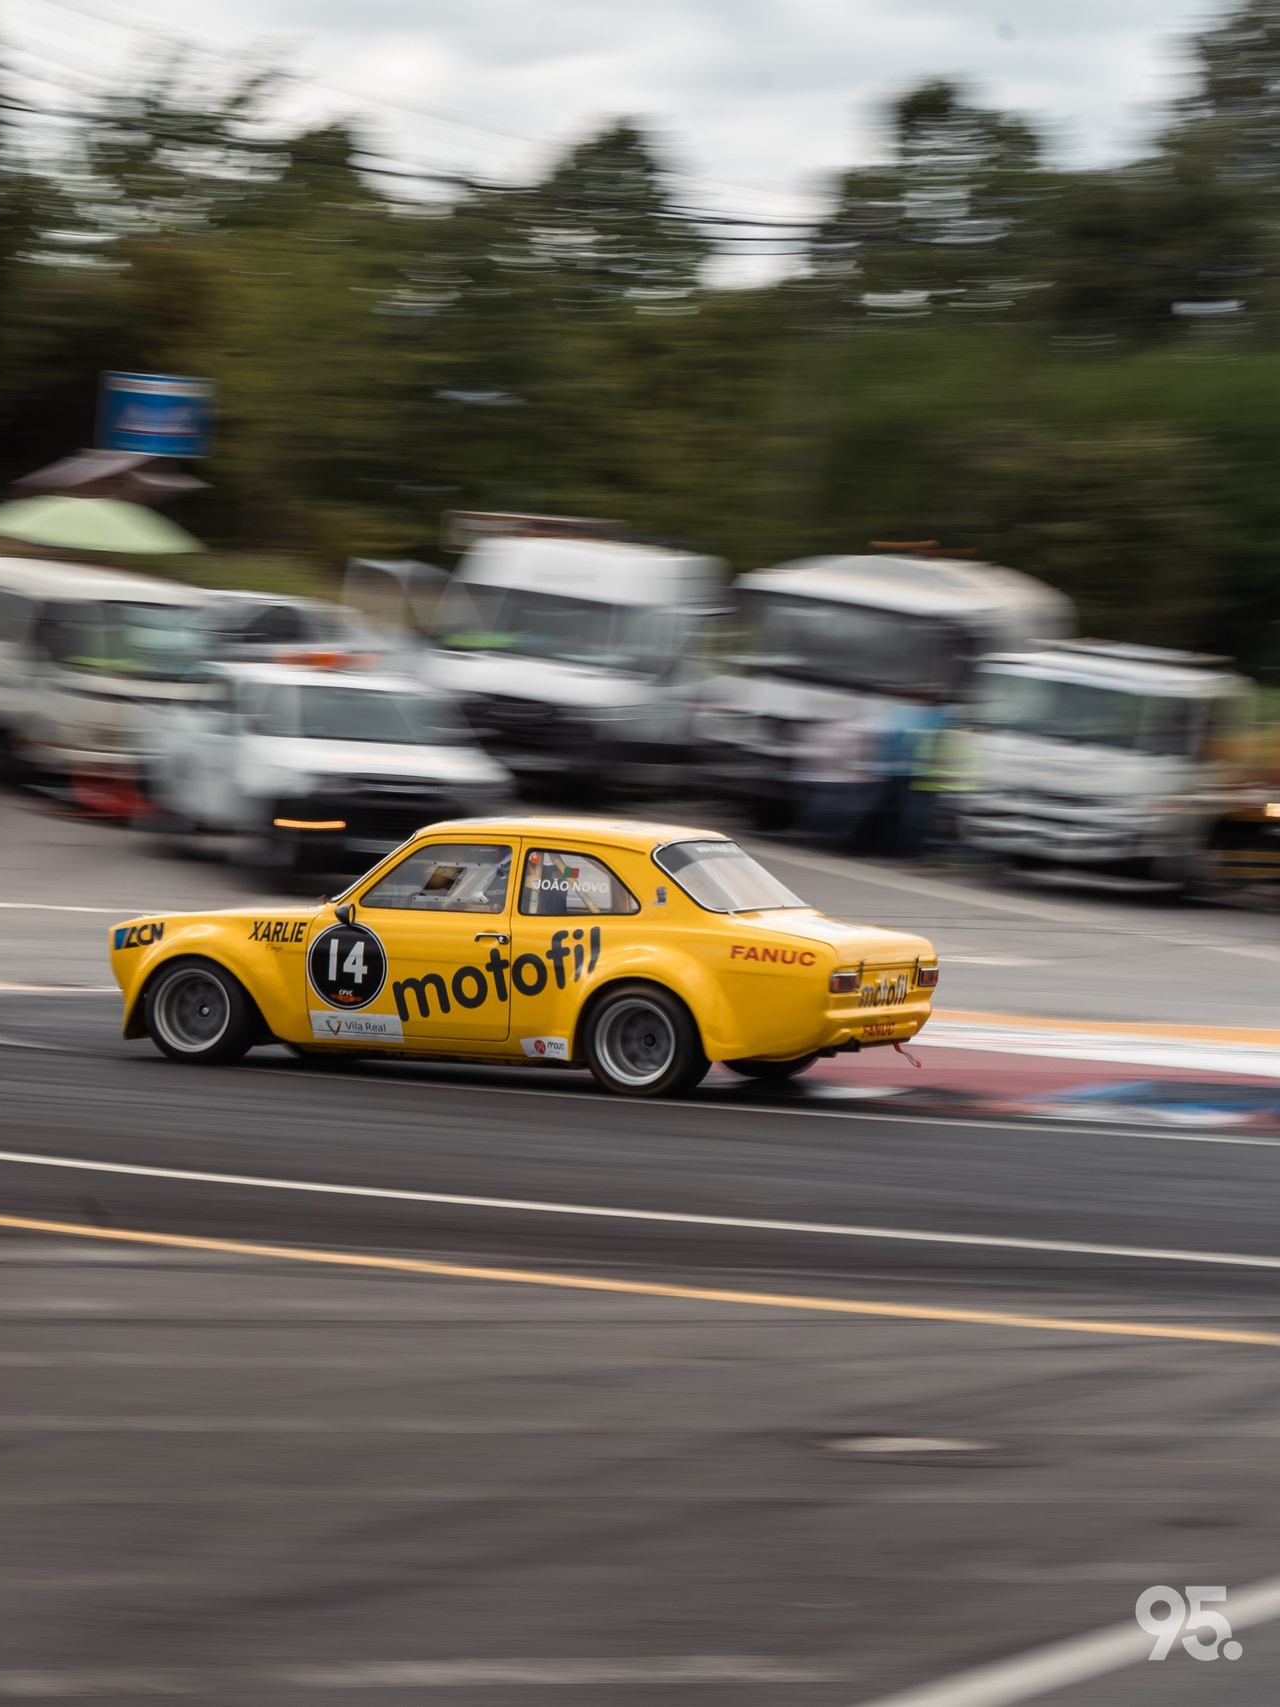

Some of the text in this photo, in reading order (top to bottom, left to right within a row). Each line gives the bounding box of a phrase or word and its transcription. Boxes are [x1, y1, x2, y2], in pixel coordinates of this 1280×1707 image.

[533, 877, 609, 894] JOÃO NOVO
[248, 921, 308, 943] XARLIE
[328, 938, 368, 984] 14
[730, 945, 816, 966] FANUC
[392, 926, 601, 1022] motofil
[857, 973, 909, 1008] motofil
[344, 1021, 387, 1032] Vila Real
[862, 1022, 896, 1039] FANUC
